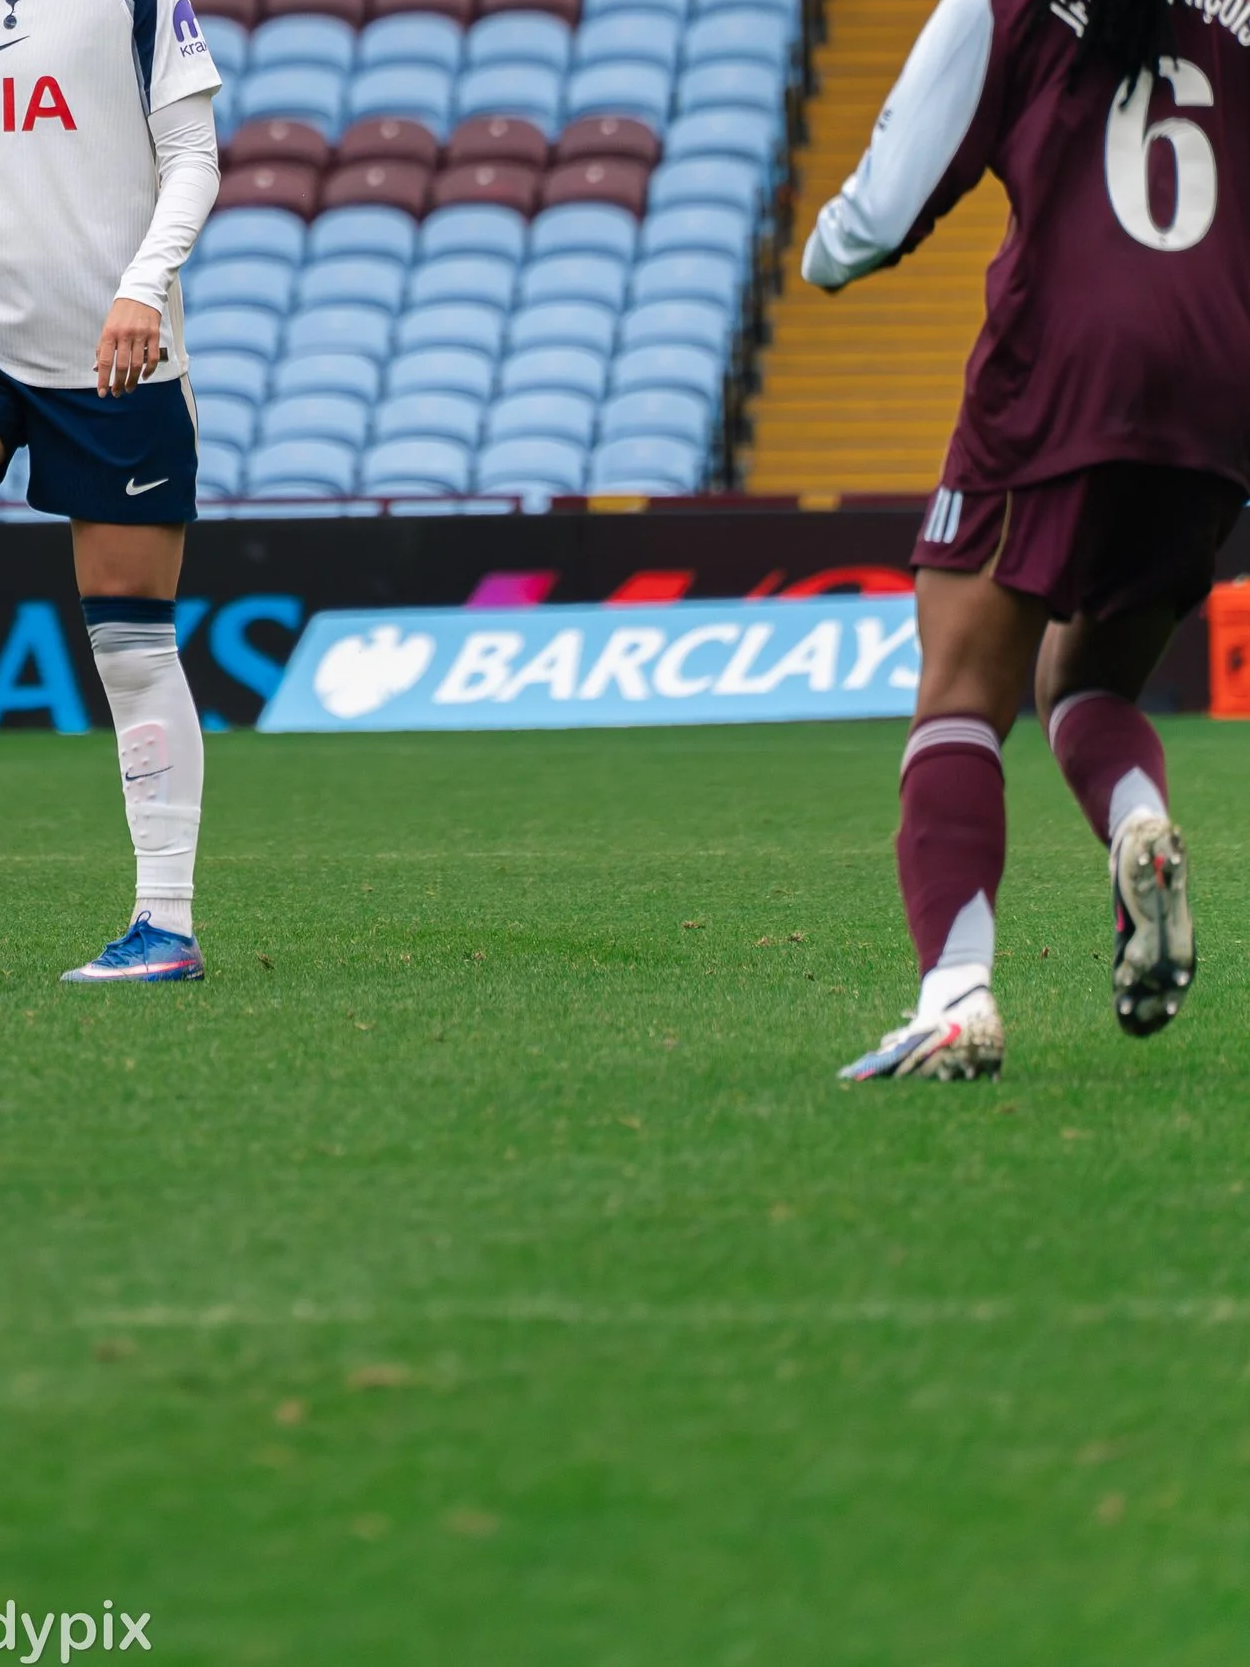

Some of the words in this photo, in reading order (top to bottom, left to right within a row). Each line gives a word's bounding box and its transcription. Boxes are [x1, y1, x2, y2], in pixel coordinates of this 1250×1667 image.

[179, 40, 207, 58] kra
[1105, 55, 1218, 252] 6
[434, 616, 921, 705] BARCLAY
